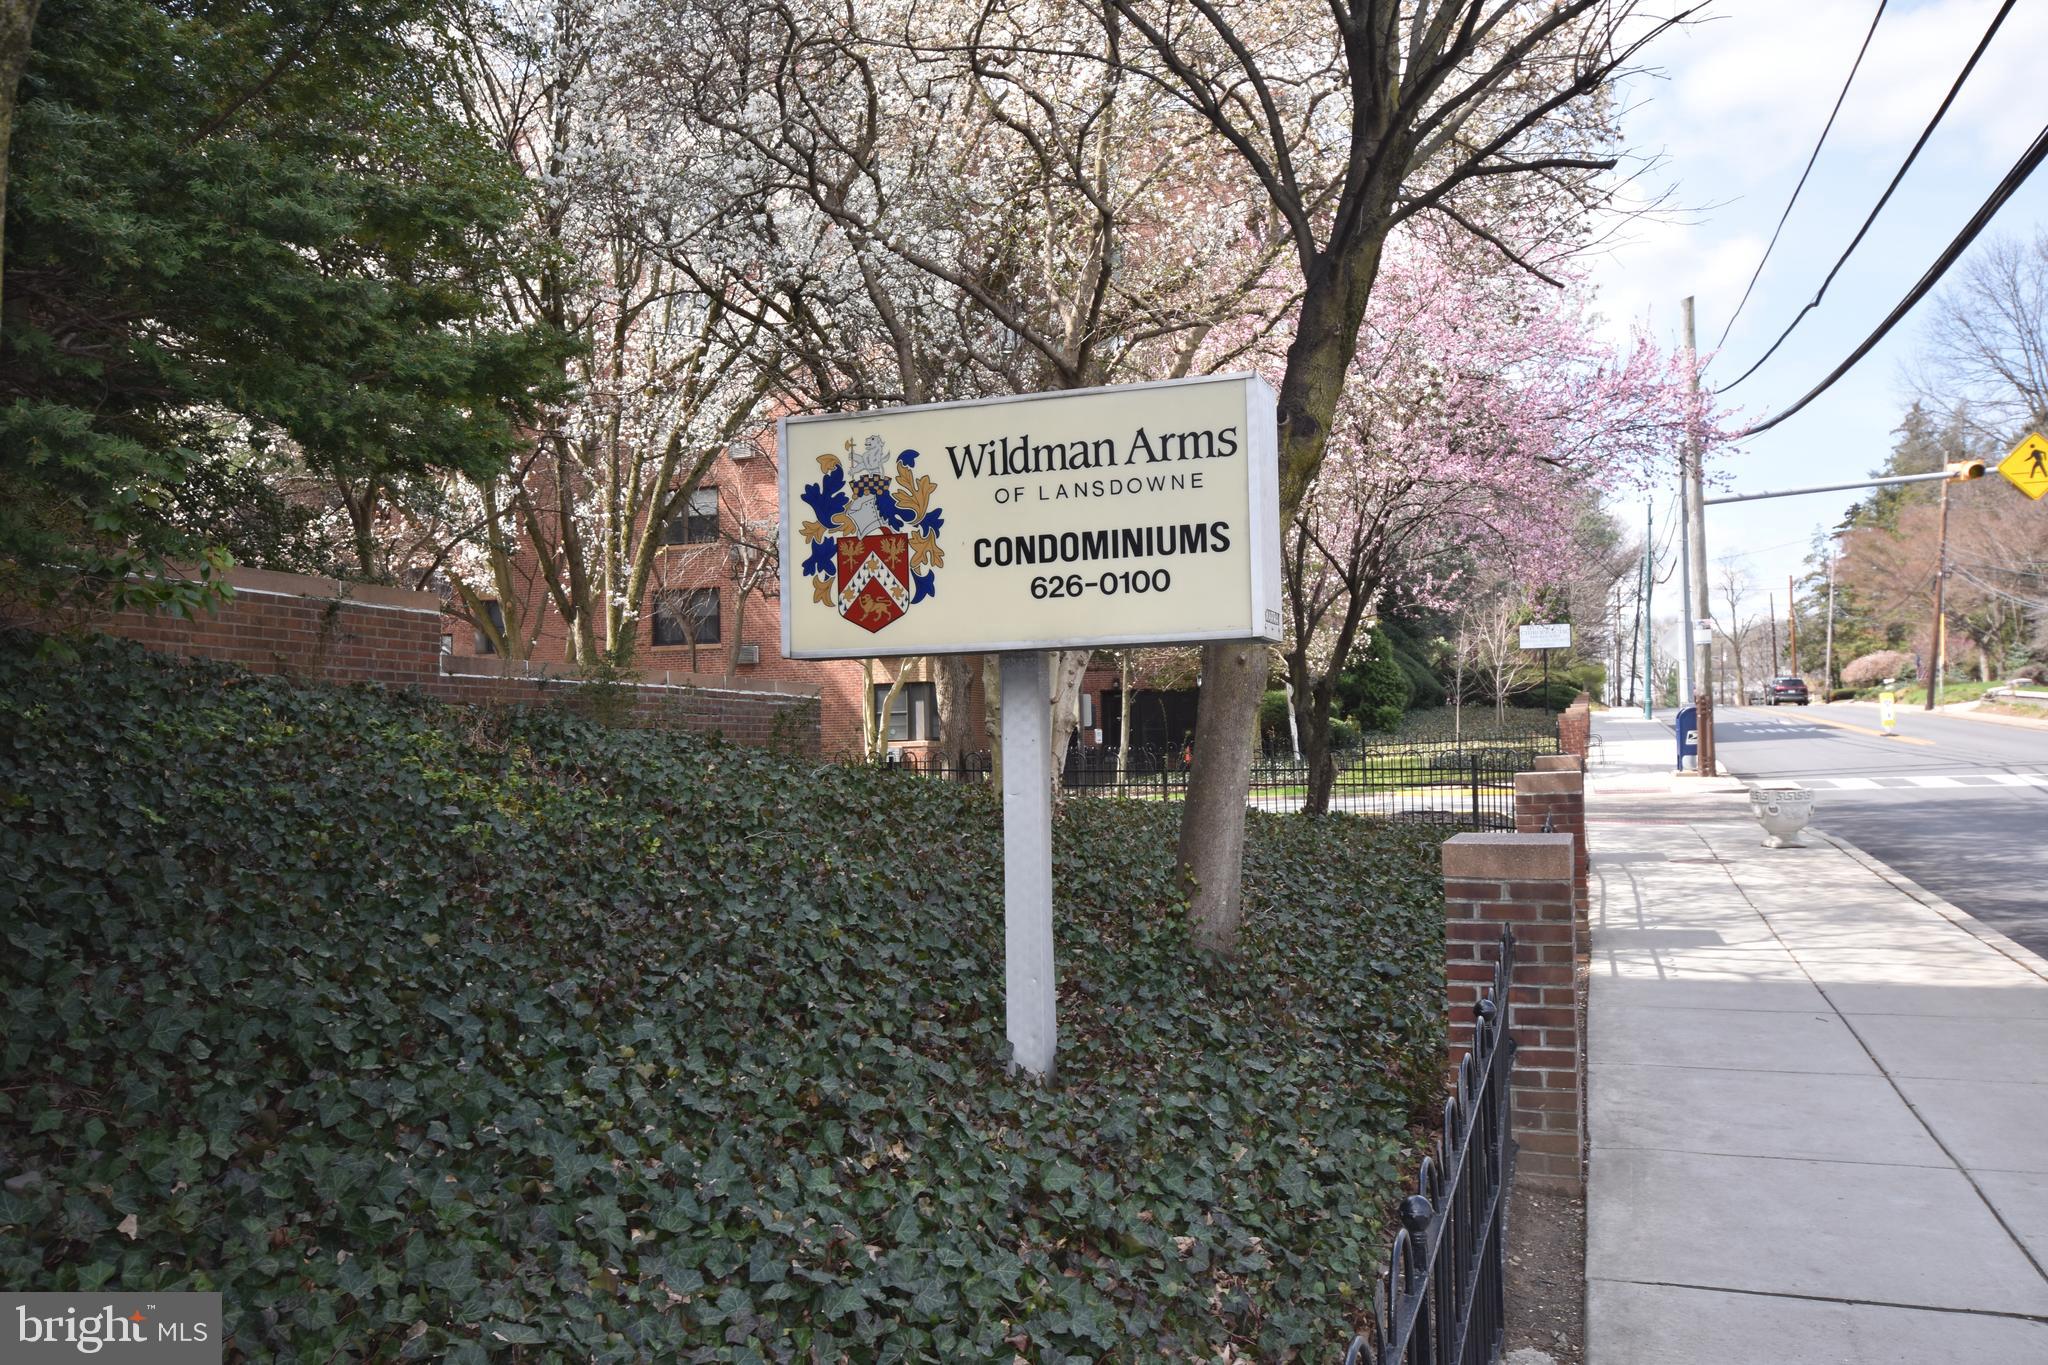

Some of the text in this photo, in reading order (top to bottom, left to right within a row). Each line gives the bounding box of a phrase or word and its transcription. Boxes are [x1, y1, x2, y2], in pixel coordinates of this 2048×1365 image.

[945, 426, 1238, 480] Wildman Arms
[994, 472, 1204, 504] OF LANSDOWNE
[973, 521, 1231, 568] CONDOMINIUMS
[1030, 568, 1171, 600] 626-0100
